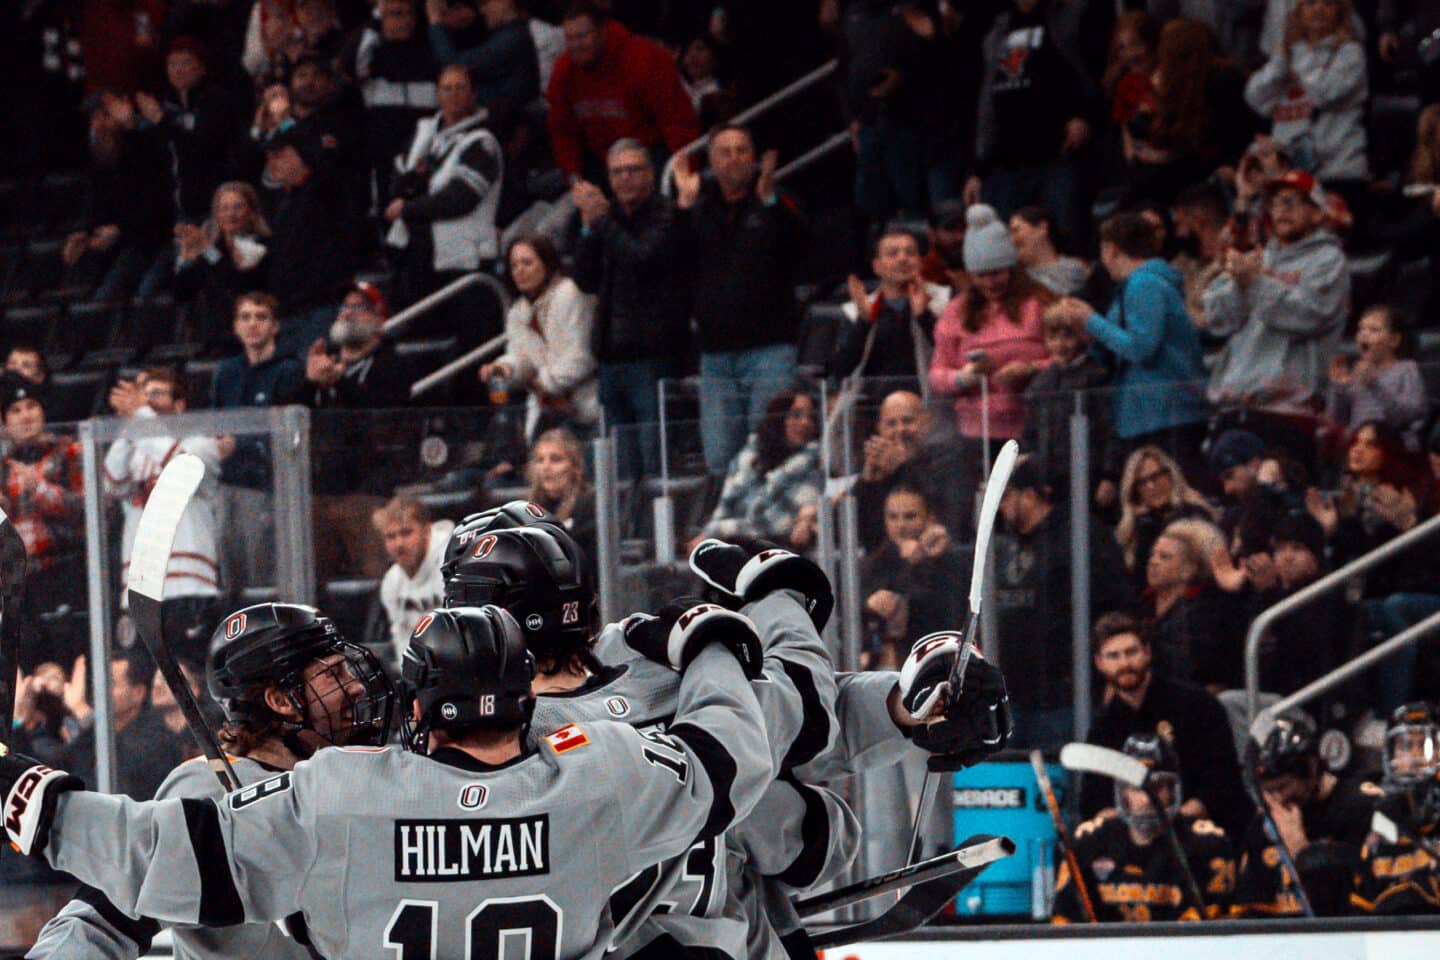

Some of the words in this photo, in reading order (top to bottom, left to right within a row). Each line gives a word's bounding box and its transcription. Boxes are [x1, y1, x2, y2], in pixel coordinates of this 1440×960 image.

[562, 601, 579, 623] 23
[480, 694, 495, 716] 18
[400, 820, 544, 876] HILMAN
